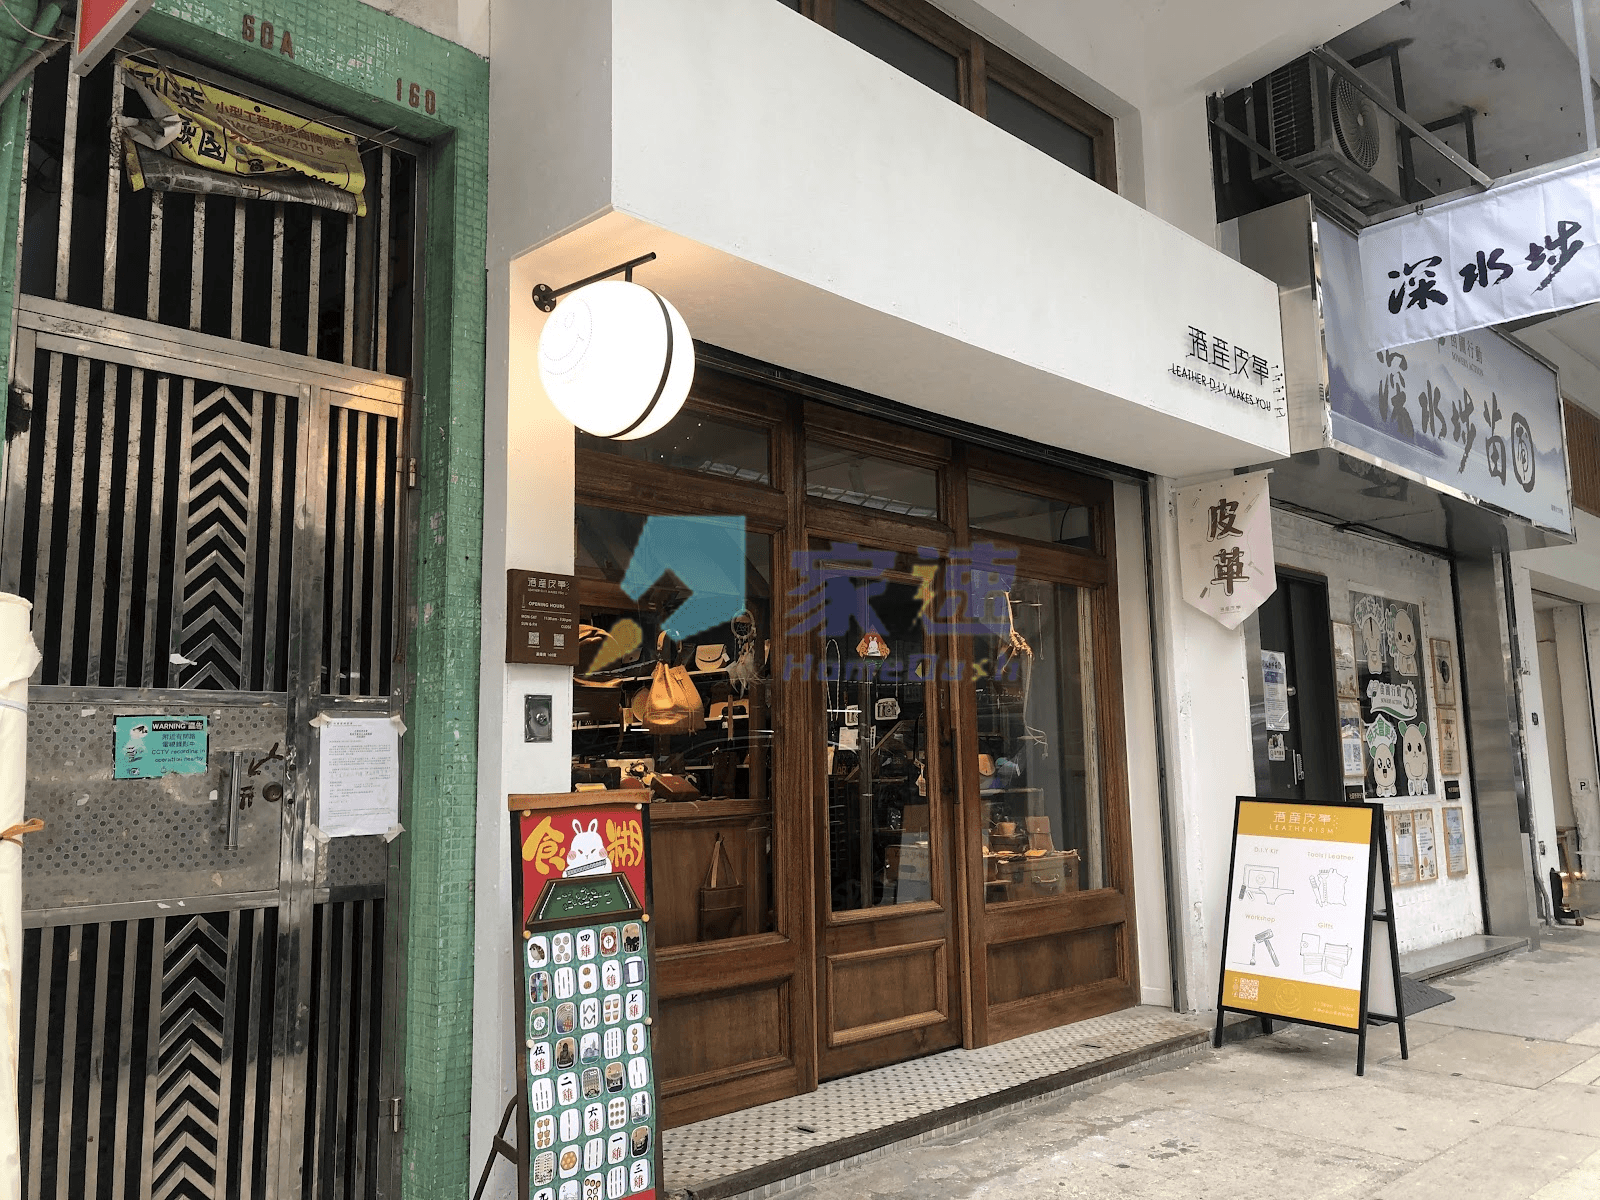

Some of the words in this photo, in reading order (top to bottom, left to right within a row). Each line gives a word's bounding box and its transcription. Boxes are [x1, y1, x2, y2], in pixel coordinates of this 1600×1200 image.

[241, 13, 295, 60] 60A
[396, 77, 436, 115] 160
[1254, 397, 1271, 412] YOU
[1206, 498, 1250, 597] 皮革
[152, 722, 186, 730] WARNING
[171, 748, 198, 756] recording
[1579, 782, 1586, 791] P
[1269, 823, 1334, 834] LEATHERISM
[1317, 922, 1334, 930] Gifts
